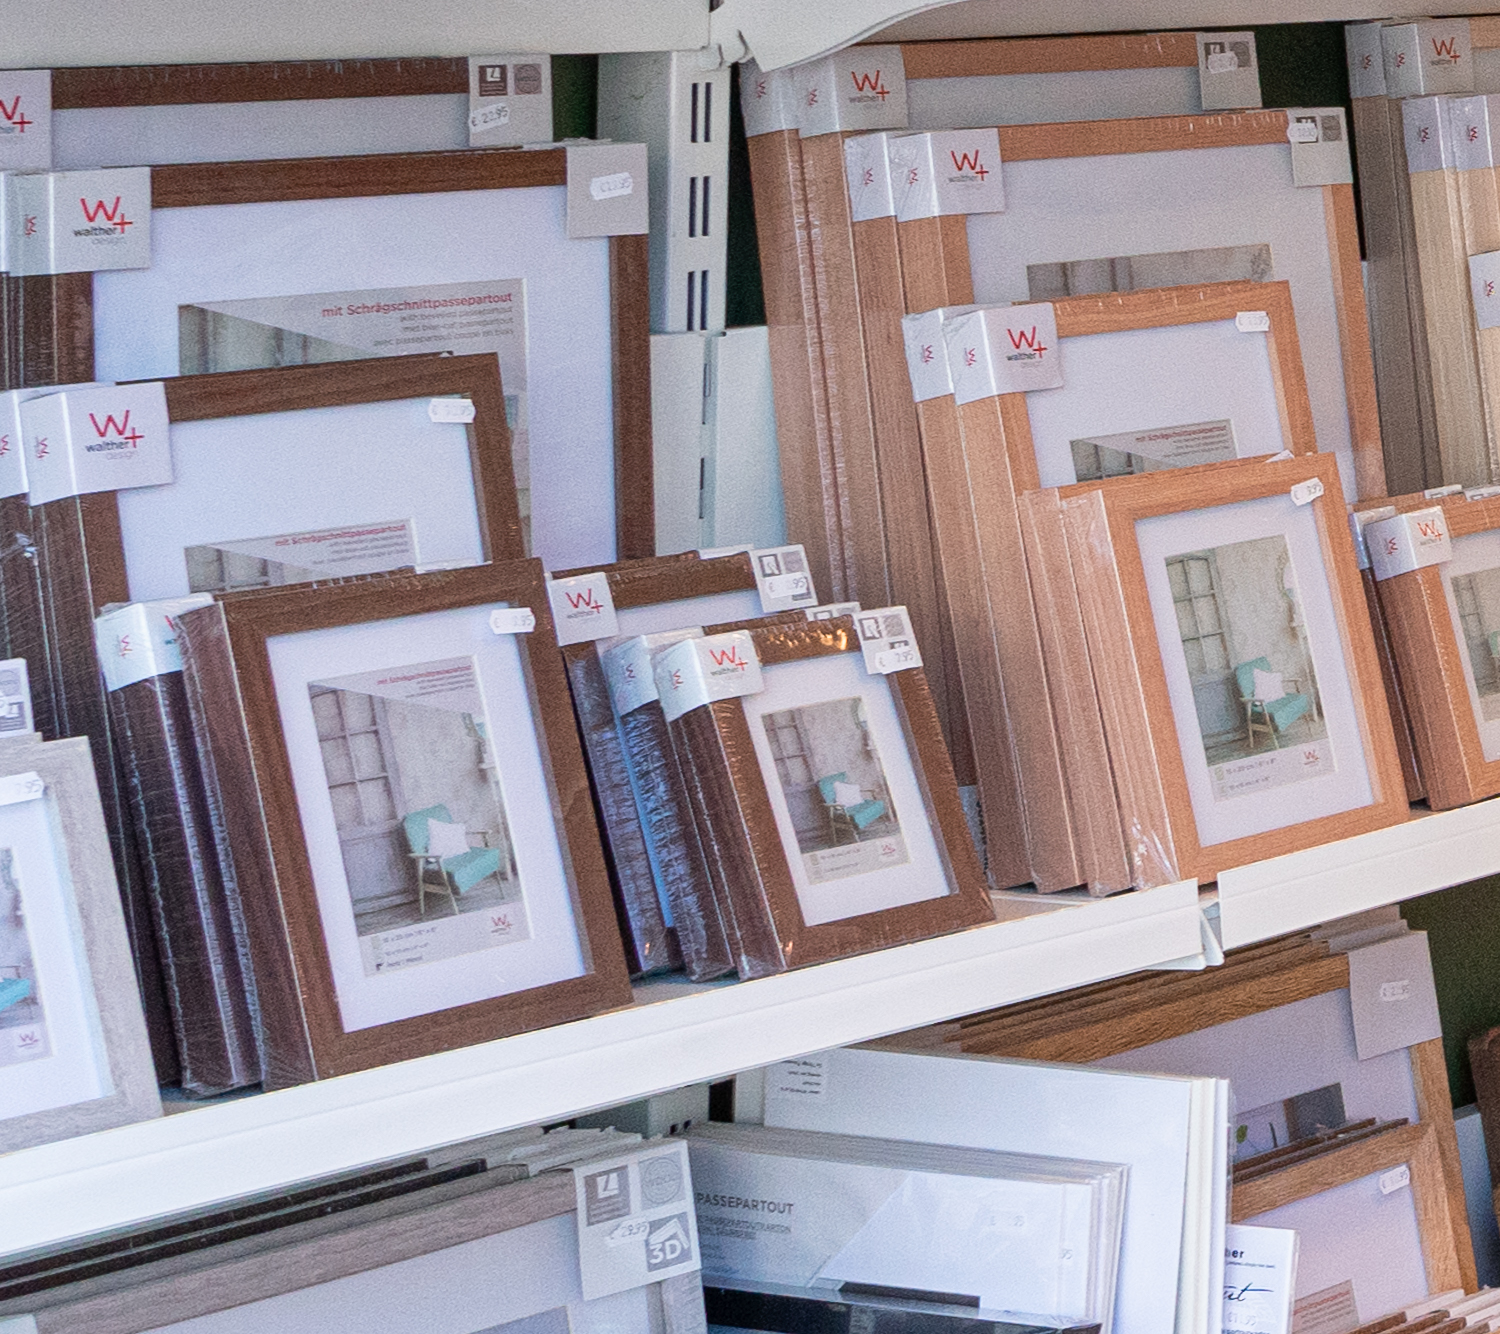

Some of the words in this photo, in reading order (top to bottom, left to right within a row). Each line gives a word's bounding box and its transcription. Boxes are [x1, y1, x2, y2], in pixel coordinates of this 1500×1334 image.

[322, 306, 343, 318] mit
[696, 1193, 795, 1215] PASSEPARTOUT
[649, 1242, 682, 1265] 3D
